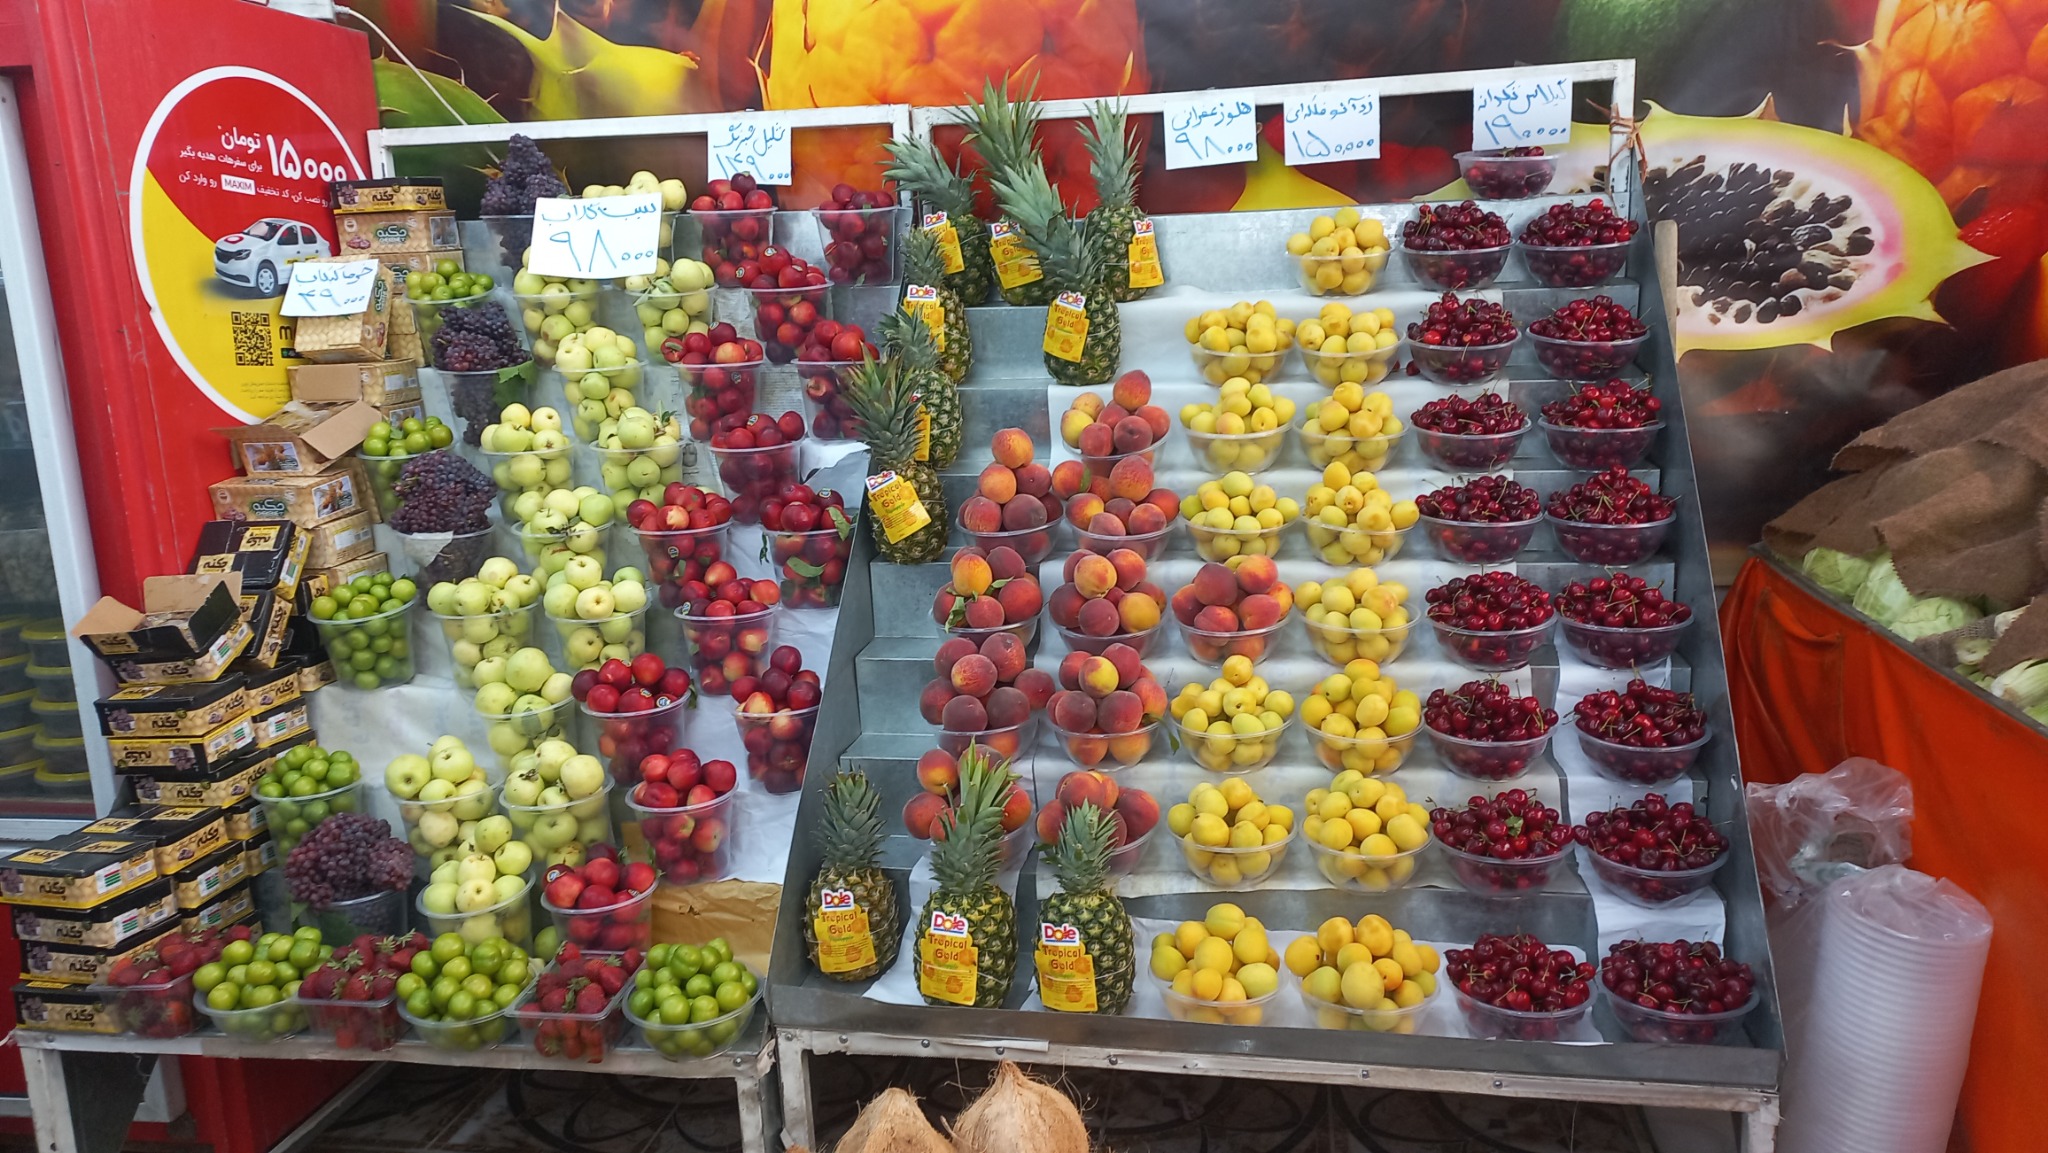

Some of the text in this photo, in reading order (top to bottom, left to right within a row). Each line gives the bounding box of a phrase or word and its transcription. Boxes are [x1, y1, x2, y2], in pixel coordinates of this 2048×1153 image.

[1226, 101, 1252, 126] هلو
[221, 127, 261, 154] تومان
[753, 122, 786, 157] شلیل
[179, 145, 195, 158] بگیر
[197, 150, 216, 162] هدیه
[248, 160, 263, 173] برای
[179, 171, 191, 183] کن
[193, 173, 208, 187] وارد
[210, 178, 217, 189] رو
[224, 178, 253, 192] MAXIM
[256, 185, 280, 197] تخفیف
[282, 189, 290, 199] کد
[304, 194, 321, 205] نصب
[925, 212, 945, 225] Dole
[1136, 221, 1152, 232] Dole
[549, 229, 654, 272] ۹۸۰۰۰
[342, 263, 374, 285] خرما
[910, 287, 935, 297] Dole
[1060, 291, 1083, 306] Dole
[1054, 304, 1082, 320] Tropical
[1056, 316, 1075, 328] Gold
[868, 471, 893, 488] Dole
[872, 481, 902, 502] Tropical
[882, 494, 901, 508] Gold
[823, 892, 851, 906] Dole
[821, 912, 857, 923] Tropical
[933, 913, 965, 931] Dole
[829, 924, 852, 935] Gold
[1044, 925, 1076, 941] Dole
[928, 933, 967, 949] Tropical
[935, 948, 959, 960] Gold
[1042, 945, 1082, 958] Tropical
[1050, 959, 1074, 970] Gold
